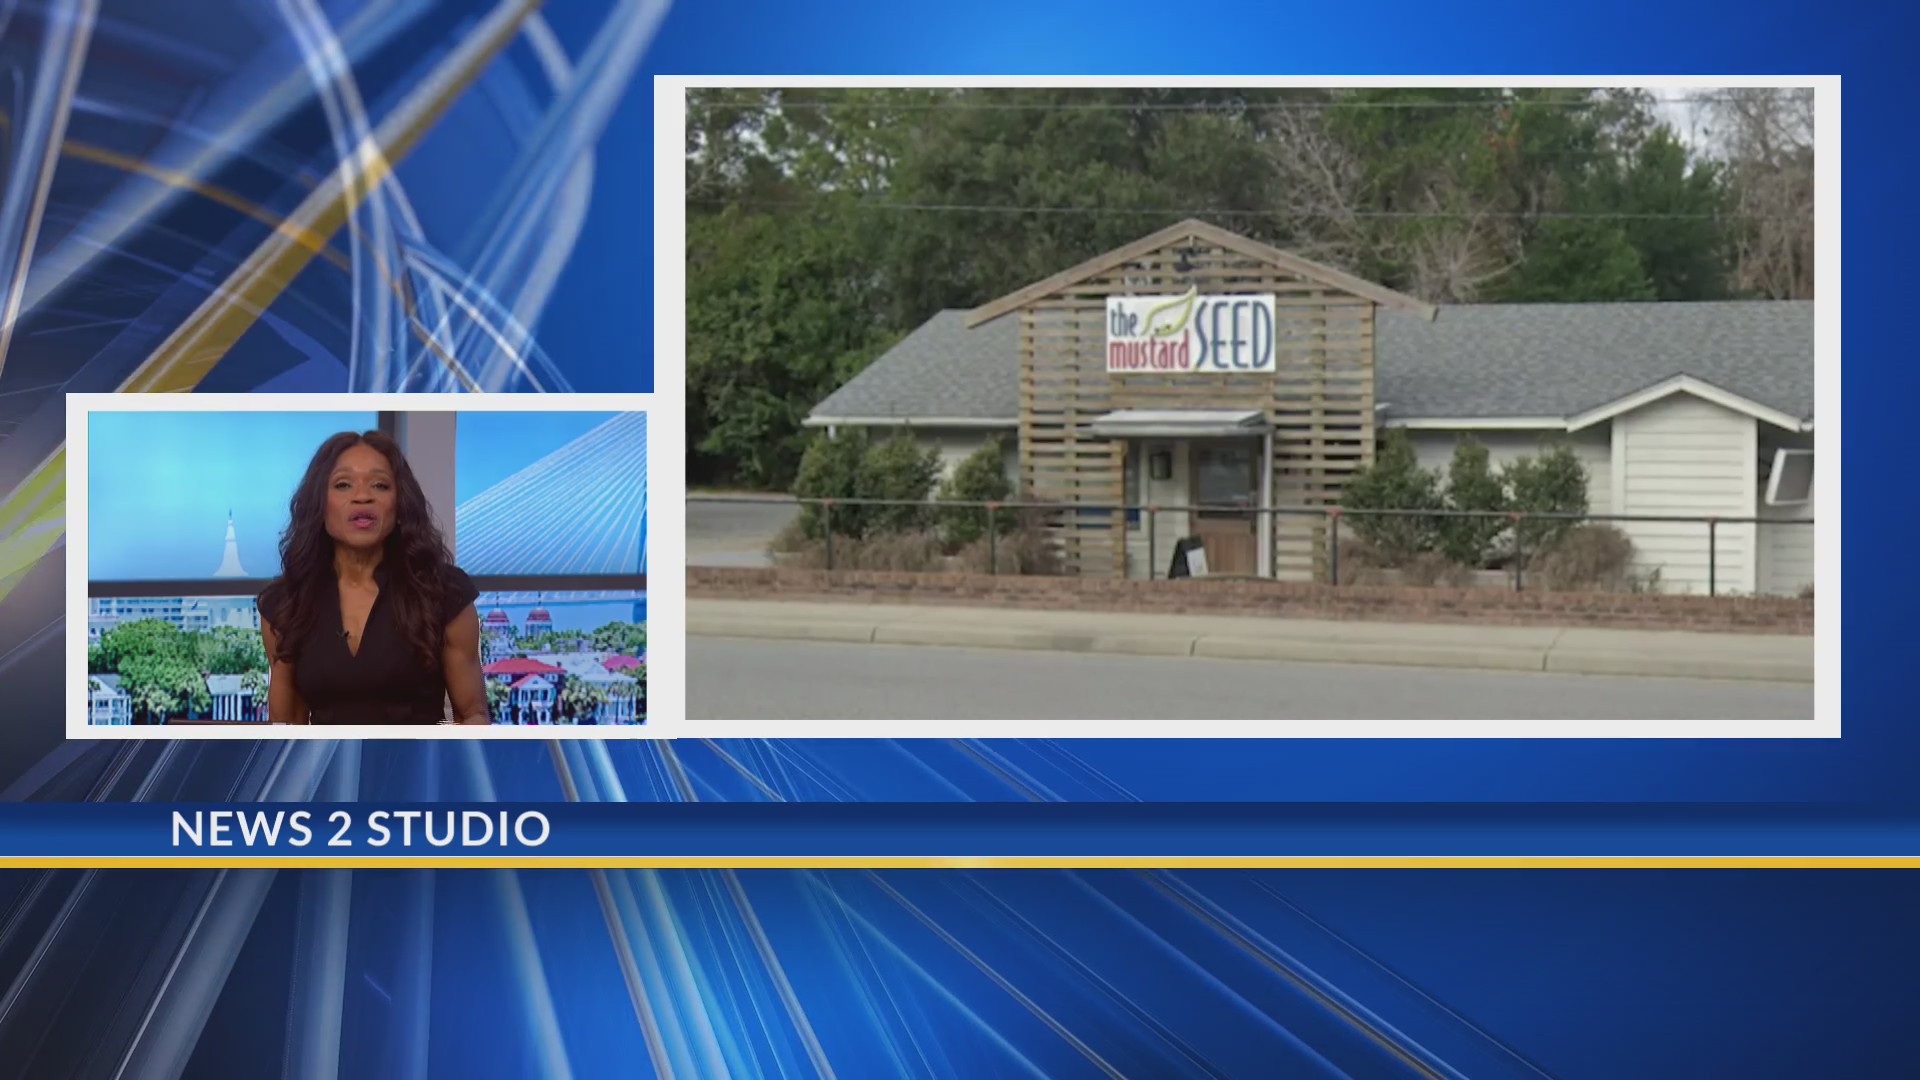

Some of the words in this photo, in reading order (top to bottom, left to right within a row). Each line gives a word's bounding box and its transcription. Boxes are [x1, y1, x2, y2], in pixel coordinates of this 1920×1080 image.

[1109, 302, 1138, 337] the
[1194, 301, 1273, 369] SEED
[1109, 328, 1190, 369] mustard
